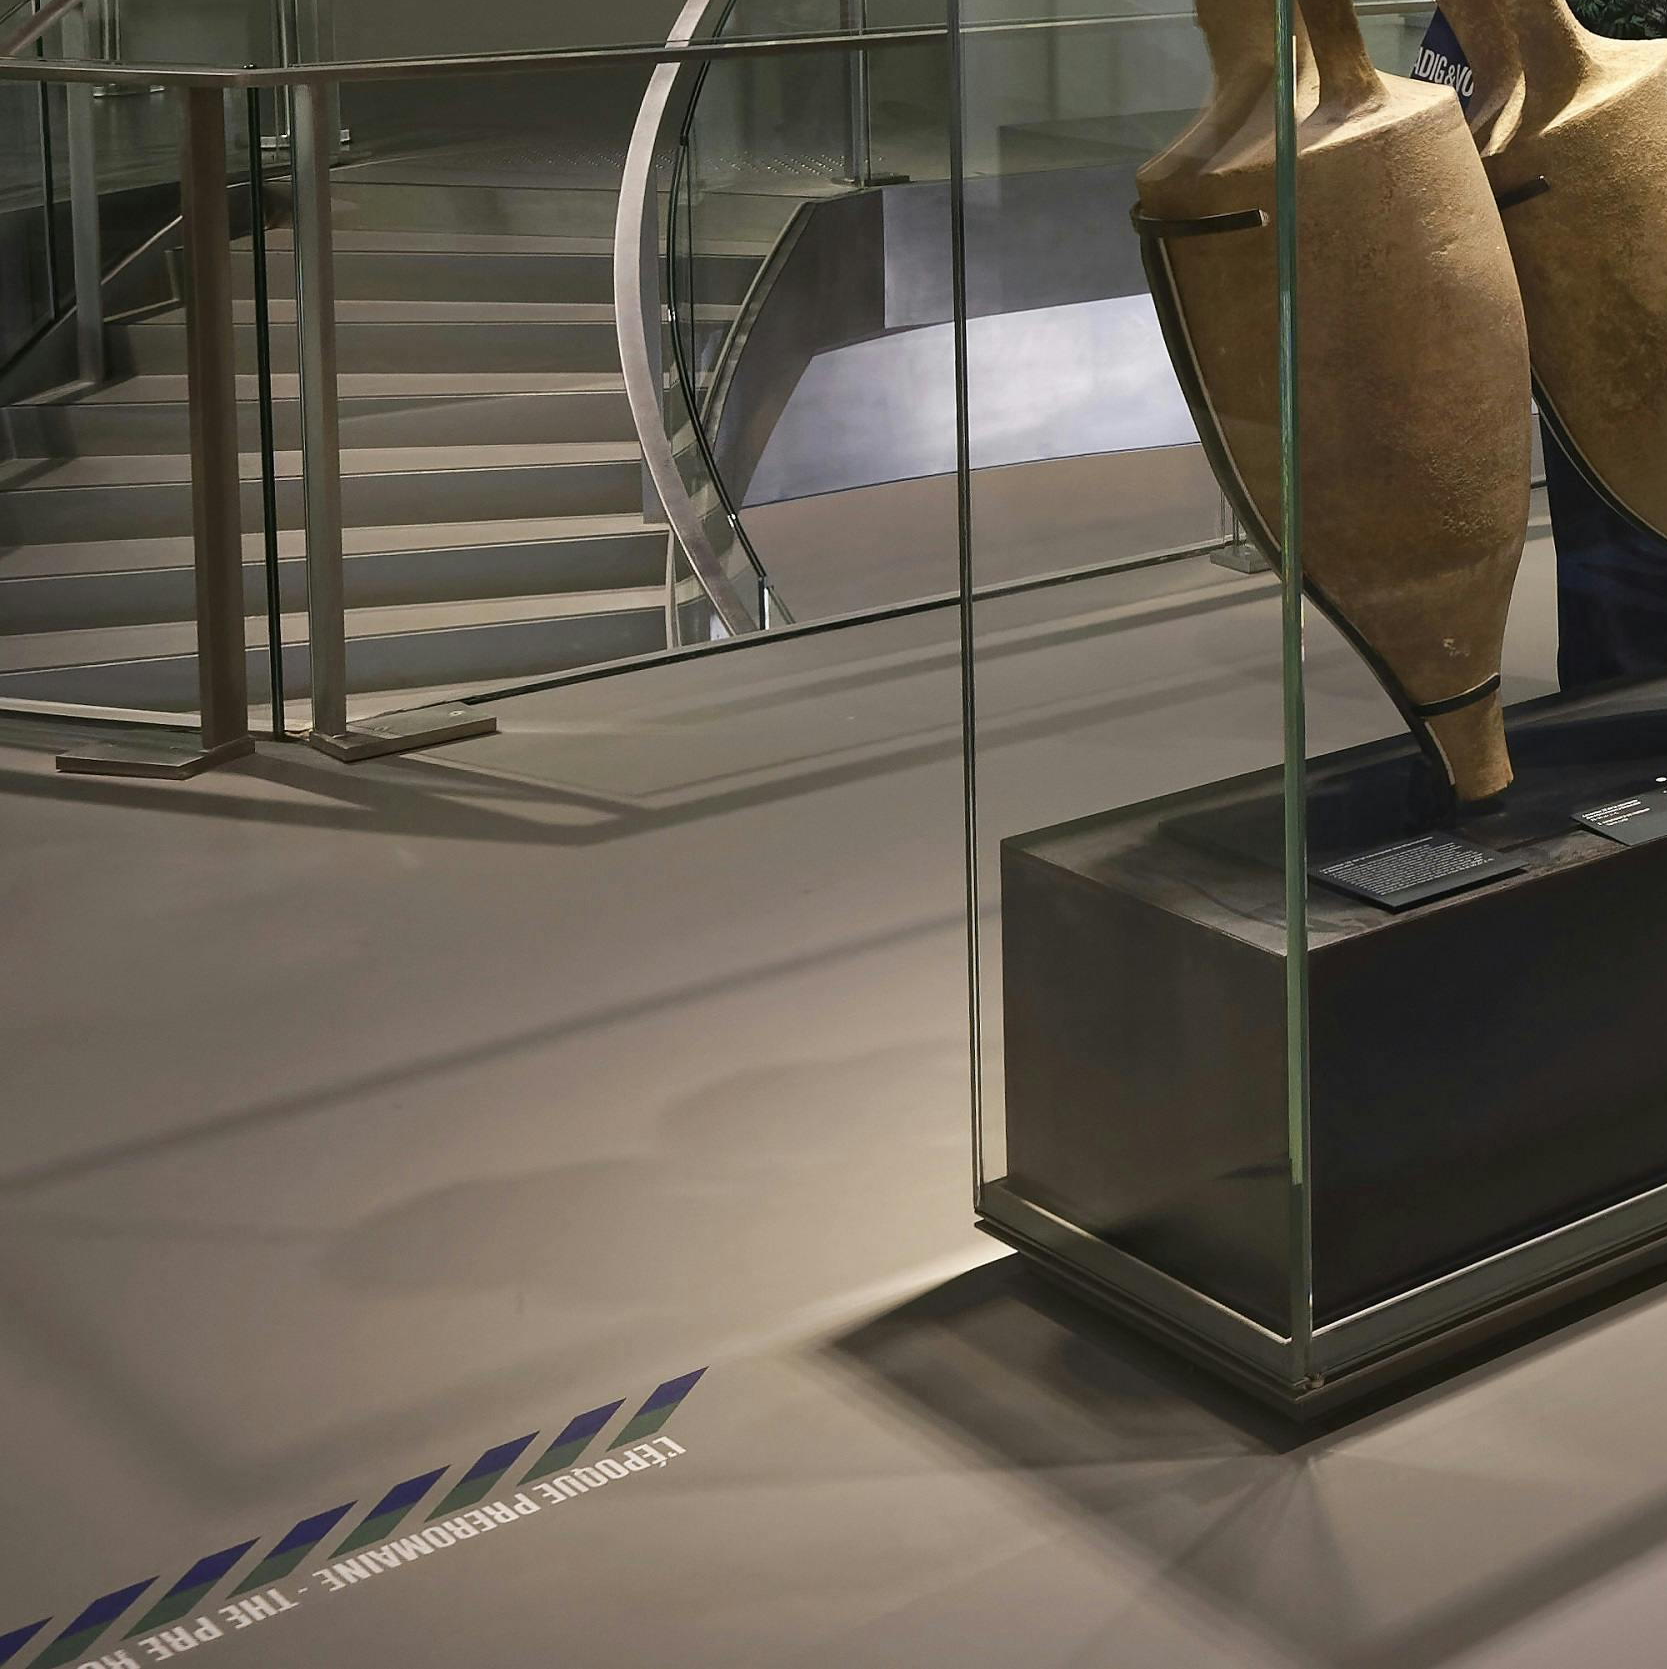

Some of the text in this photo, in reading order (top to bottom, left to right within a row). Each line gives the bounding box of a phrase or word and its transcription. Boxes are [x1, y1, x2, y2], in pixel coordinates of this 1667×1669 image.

[532, 1435, 687, 1505] L'ÉPOQUE
[312, 1491, 543, 1593] PREROMAINE
[217, 1587, 299, 1630] THE
[137, 1616, 225, 1662] PRE
